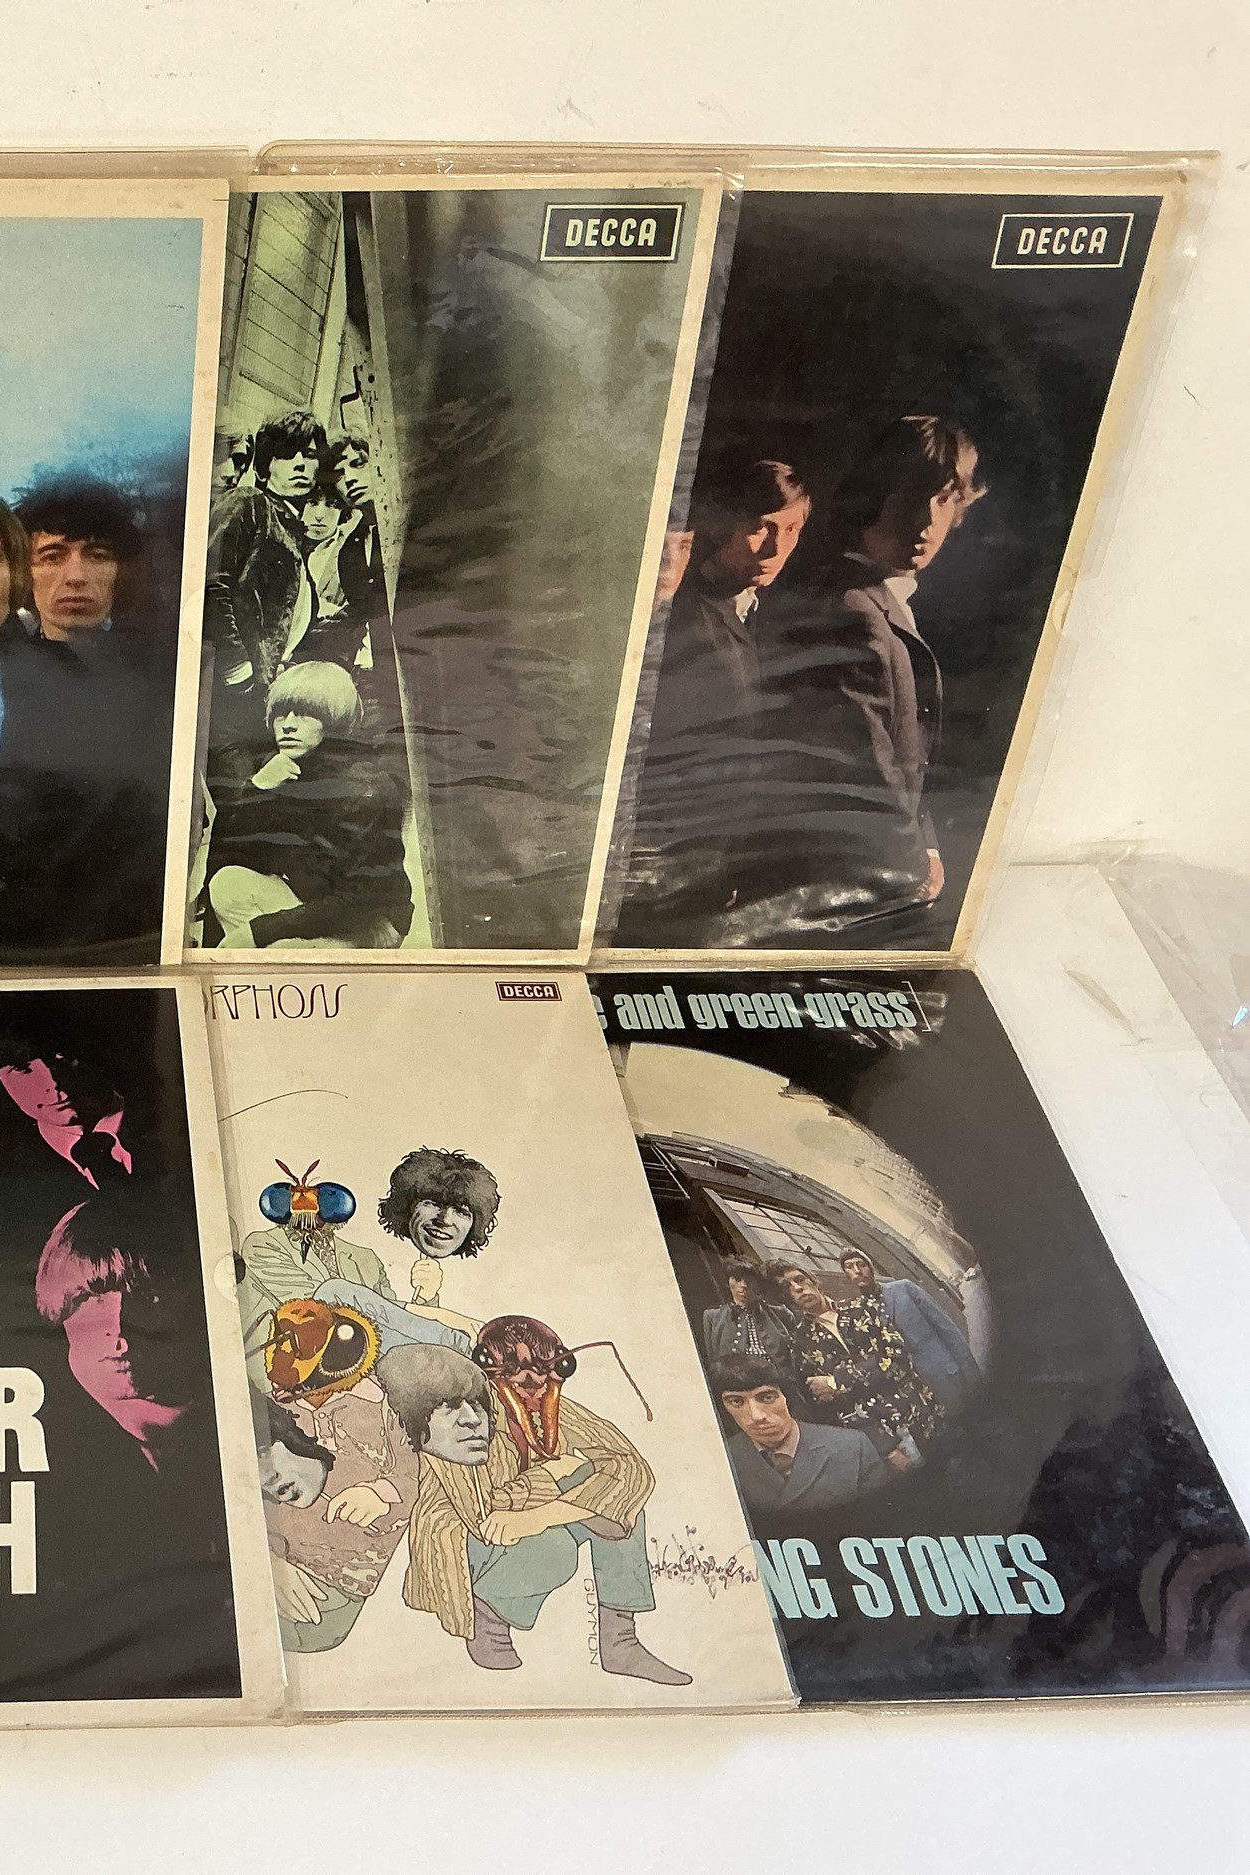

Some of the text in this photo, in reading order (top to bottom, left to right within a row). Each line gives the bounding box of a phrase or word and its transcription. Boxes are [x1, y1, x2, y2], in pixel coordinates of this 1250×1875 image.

[565, 218, 657, 247] DECCA
[1016, 226, 1108, 255] DECCA
[503, 985, 555, 998] DECCA
[613, 985, 685, 1030] and
[687, 991, 800, 1030] green
[838, 1533, 1067, 1619] STONES
[583, 1577, 600, 1666] GUYMON
